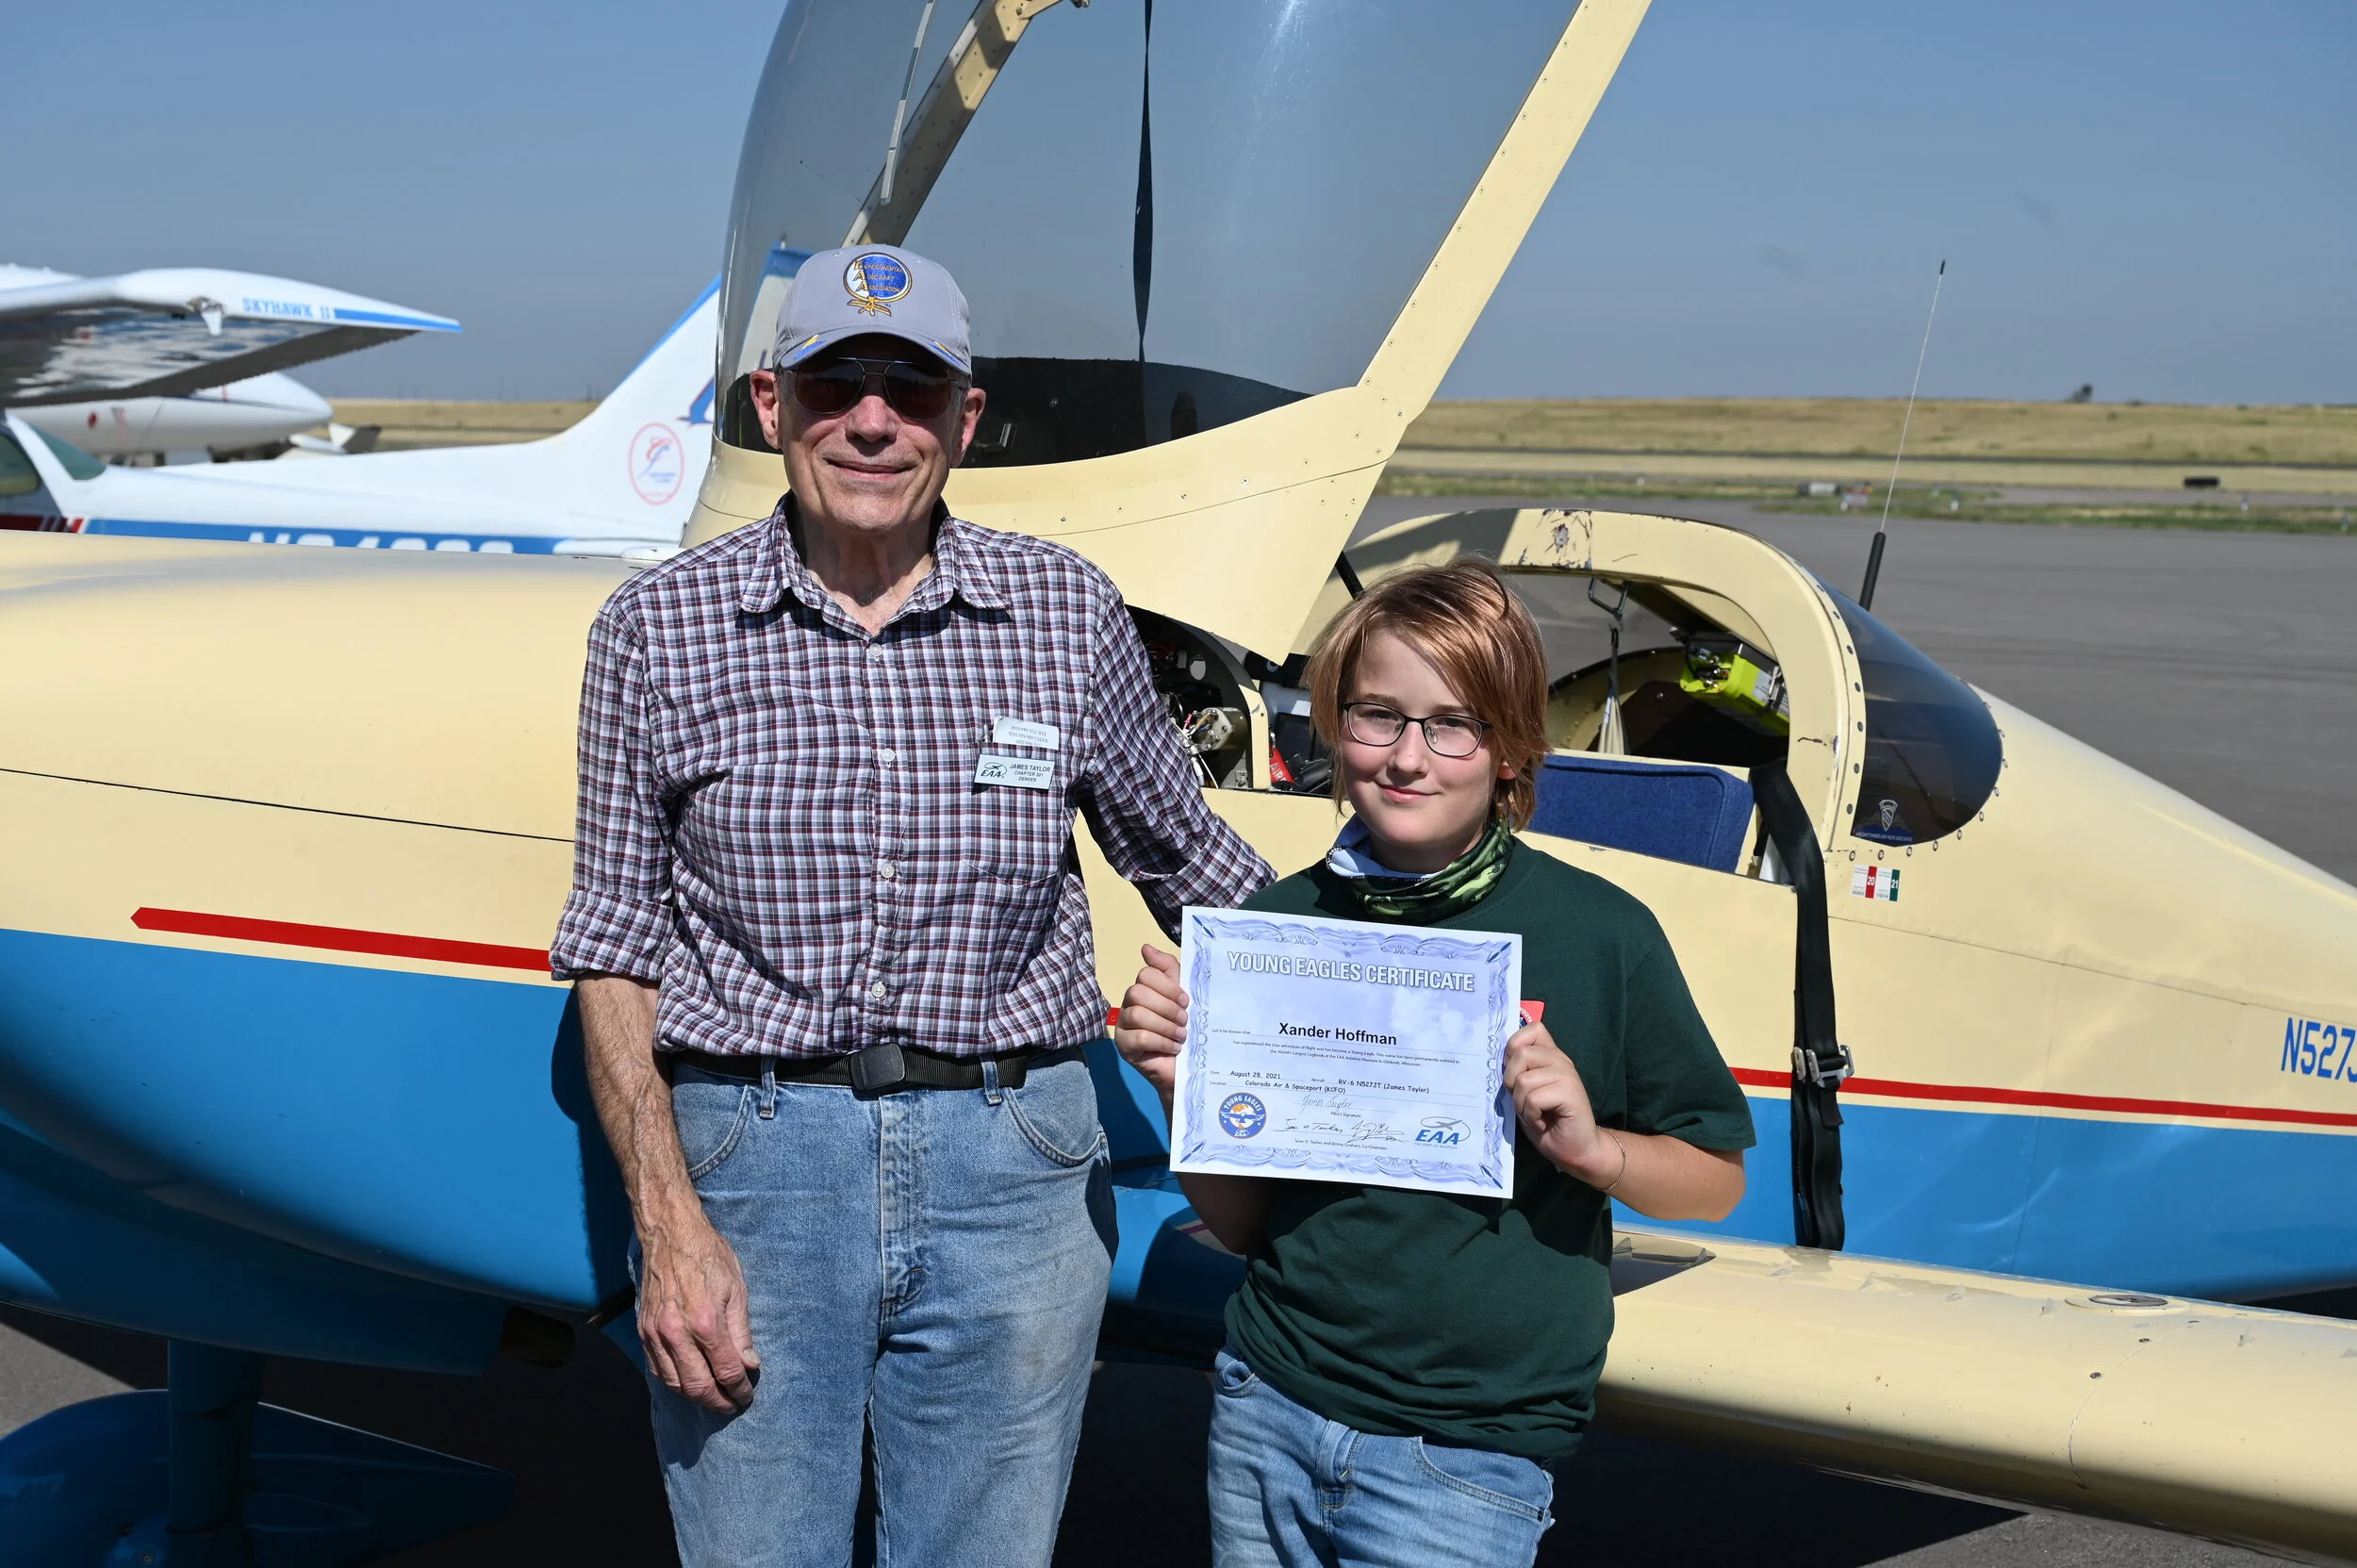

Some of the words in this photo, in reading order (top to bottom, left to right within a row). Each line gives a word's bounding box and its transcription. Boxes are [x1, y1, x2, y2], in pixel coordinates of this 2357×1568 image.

[242, 297, 312, 318] SKYHAWK
[981, 769, 1001, 778] EAA
[1867, 876, 1875, 886] 20
[1890, 879, 1899, 889] 21
[1228, 951, 1292, 975] YOUNG
[1295, 958, 1362, 982] EAGLES
[1365, 965, 1475, 992] CERTIFICATE
[1278, 1022, 1331, 1039] Xander
[1335, 1028, 1397, 1046] Hoffman
[1292, 1083, 1322, 1092] Spaceport
[1324, 1086, 1346, 1095] (KCFO)
[1408, 1085, 1430, 1094] Taylor)
[1224, 1095, 1243, 1109] YOUNG
[1244, 1095, 1262, 1112] EAGLES
[1415, 1130, 1459, 1145] EAA
